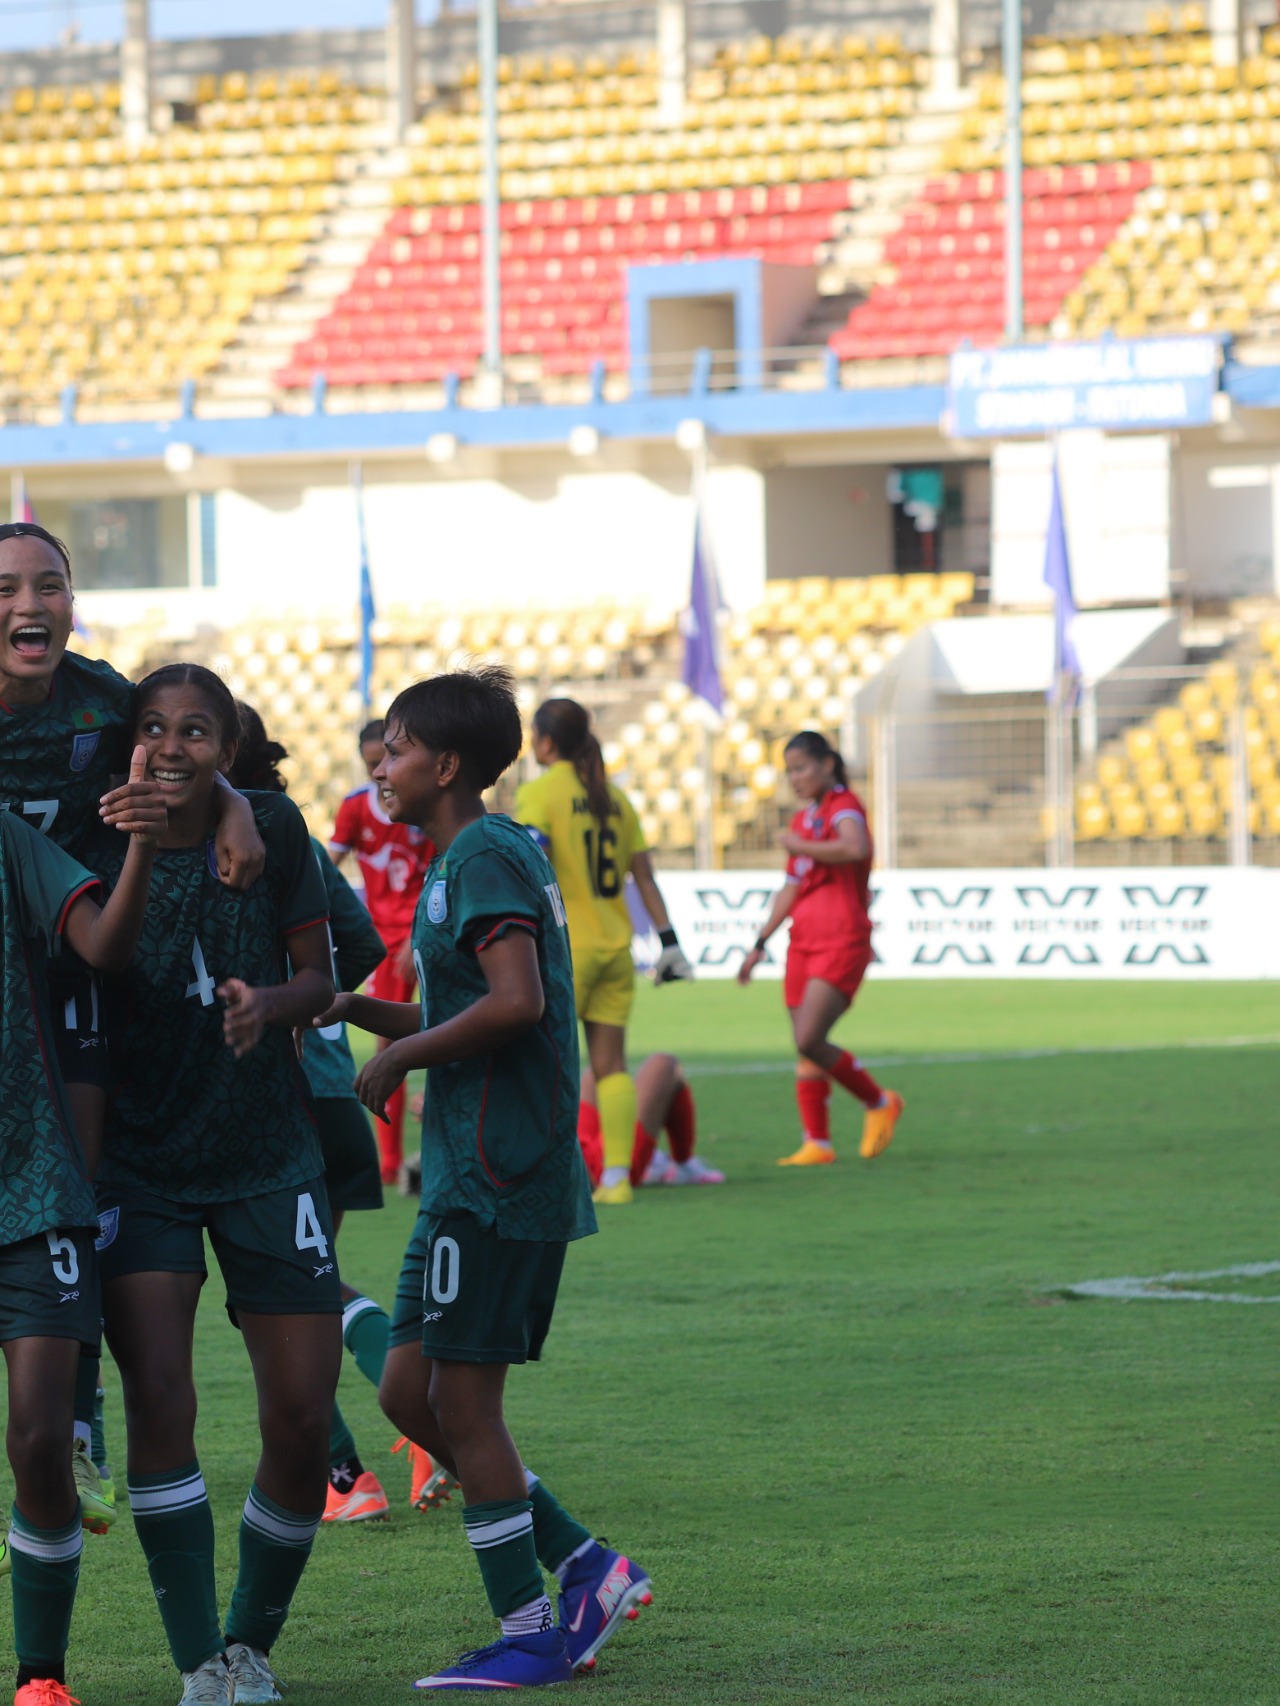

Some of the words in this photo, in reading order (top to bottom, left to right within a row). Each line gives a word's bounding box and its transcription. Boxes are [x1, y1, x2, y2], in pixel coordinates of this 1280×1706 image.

[584, 829, 620, 898] 16
[185, 935, 216, 1007] 4
[46, 1229, 79, 1285] 5
[295, 1192, 328, 1258] 4
